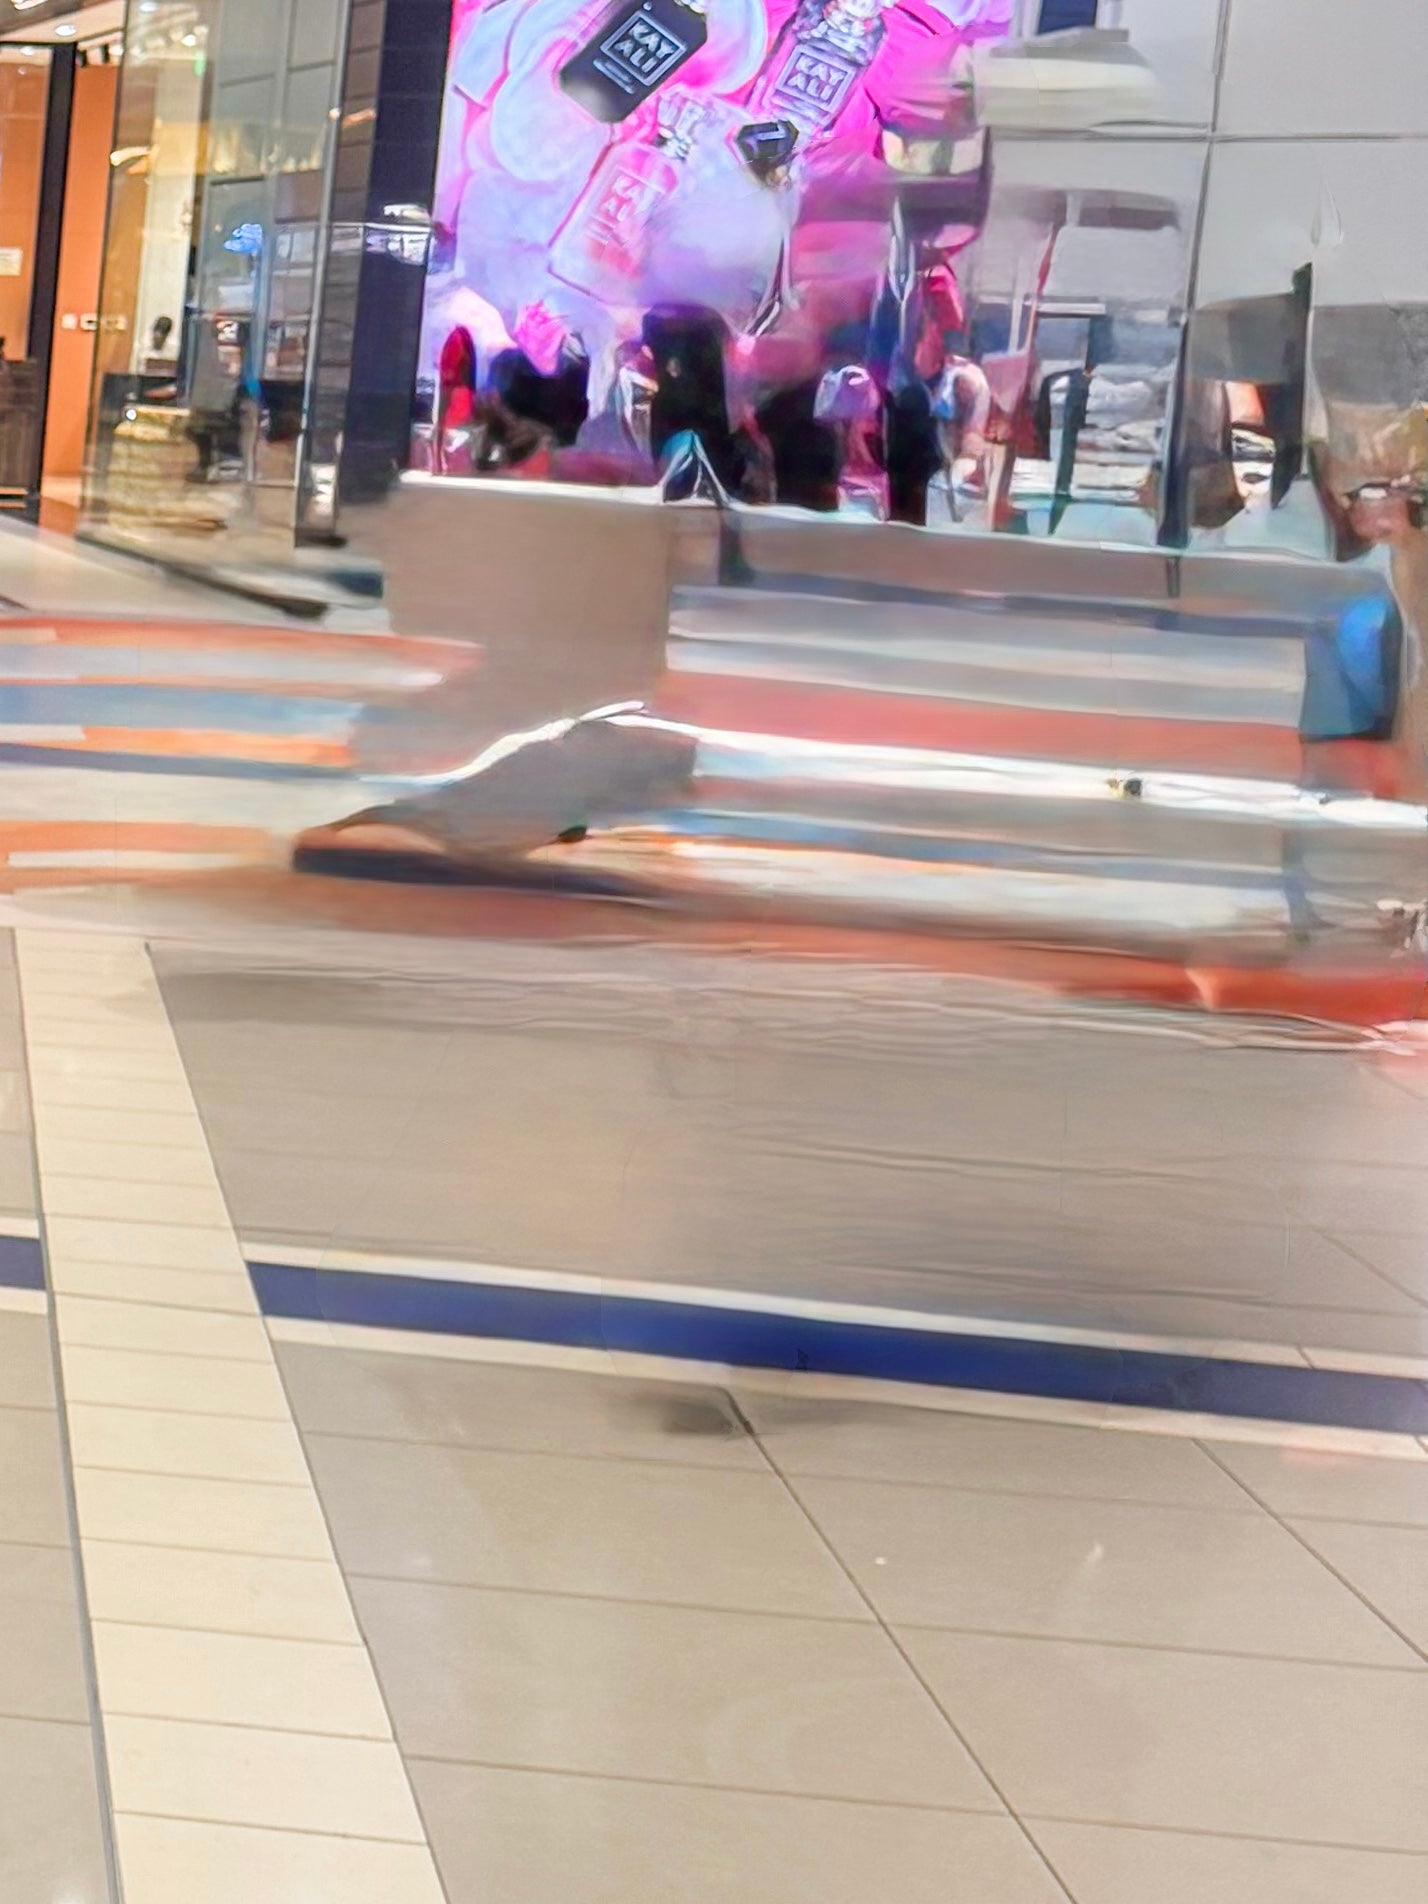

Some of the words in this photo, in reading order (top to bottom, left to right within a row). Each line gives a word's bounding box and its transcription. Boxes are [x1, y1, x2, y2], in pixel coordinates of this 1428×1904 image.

[613, 39, 658, 73] ALI
[629, 20, 675, 60] KAY
[786, 72, 834, 101] ALI
[795, 56, 846, 86] KAY
